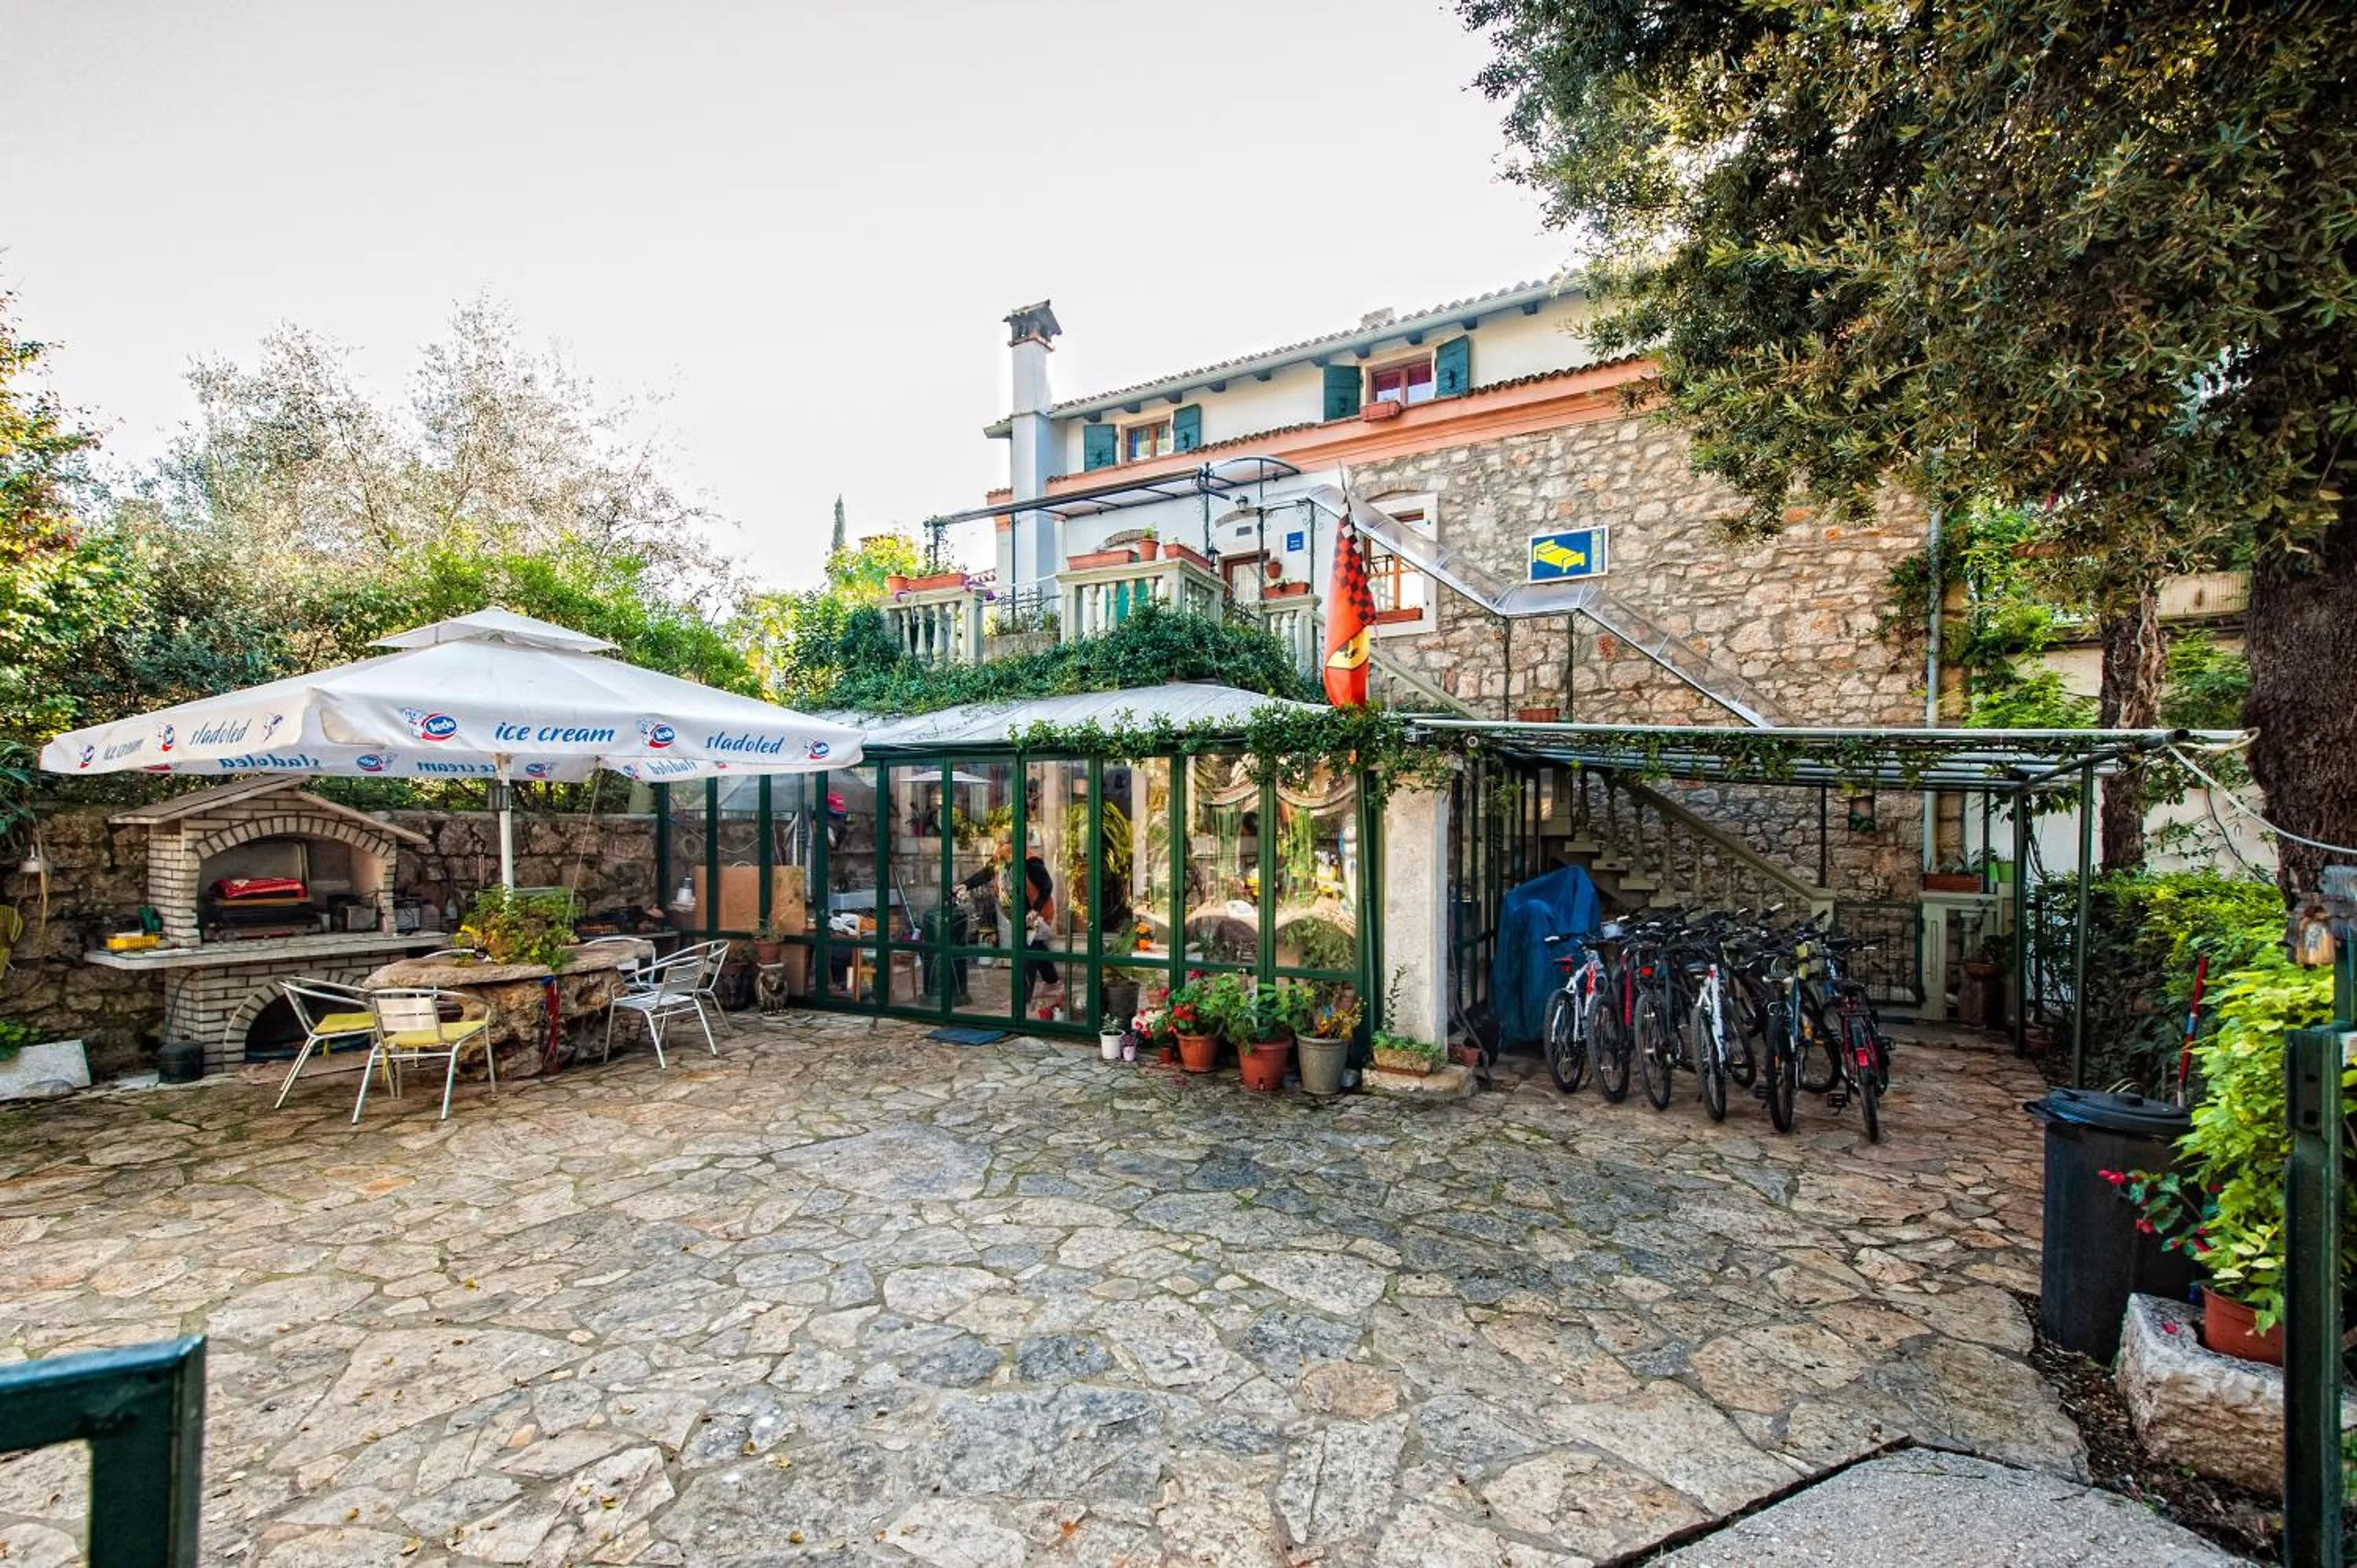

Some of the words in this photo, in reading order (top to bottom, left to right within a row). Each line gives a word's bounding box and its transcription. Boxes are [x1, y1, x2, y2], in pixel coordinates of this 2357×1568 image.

[495, 722, 530, 741] ice
[537, 726, 615, 742] cream
[705, 731, 785, 754] sladoled
